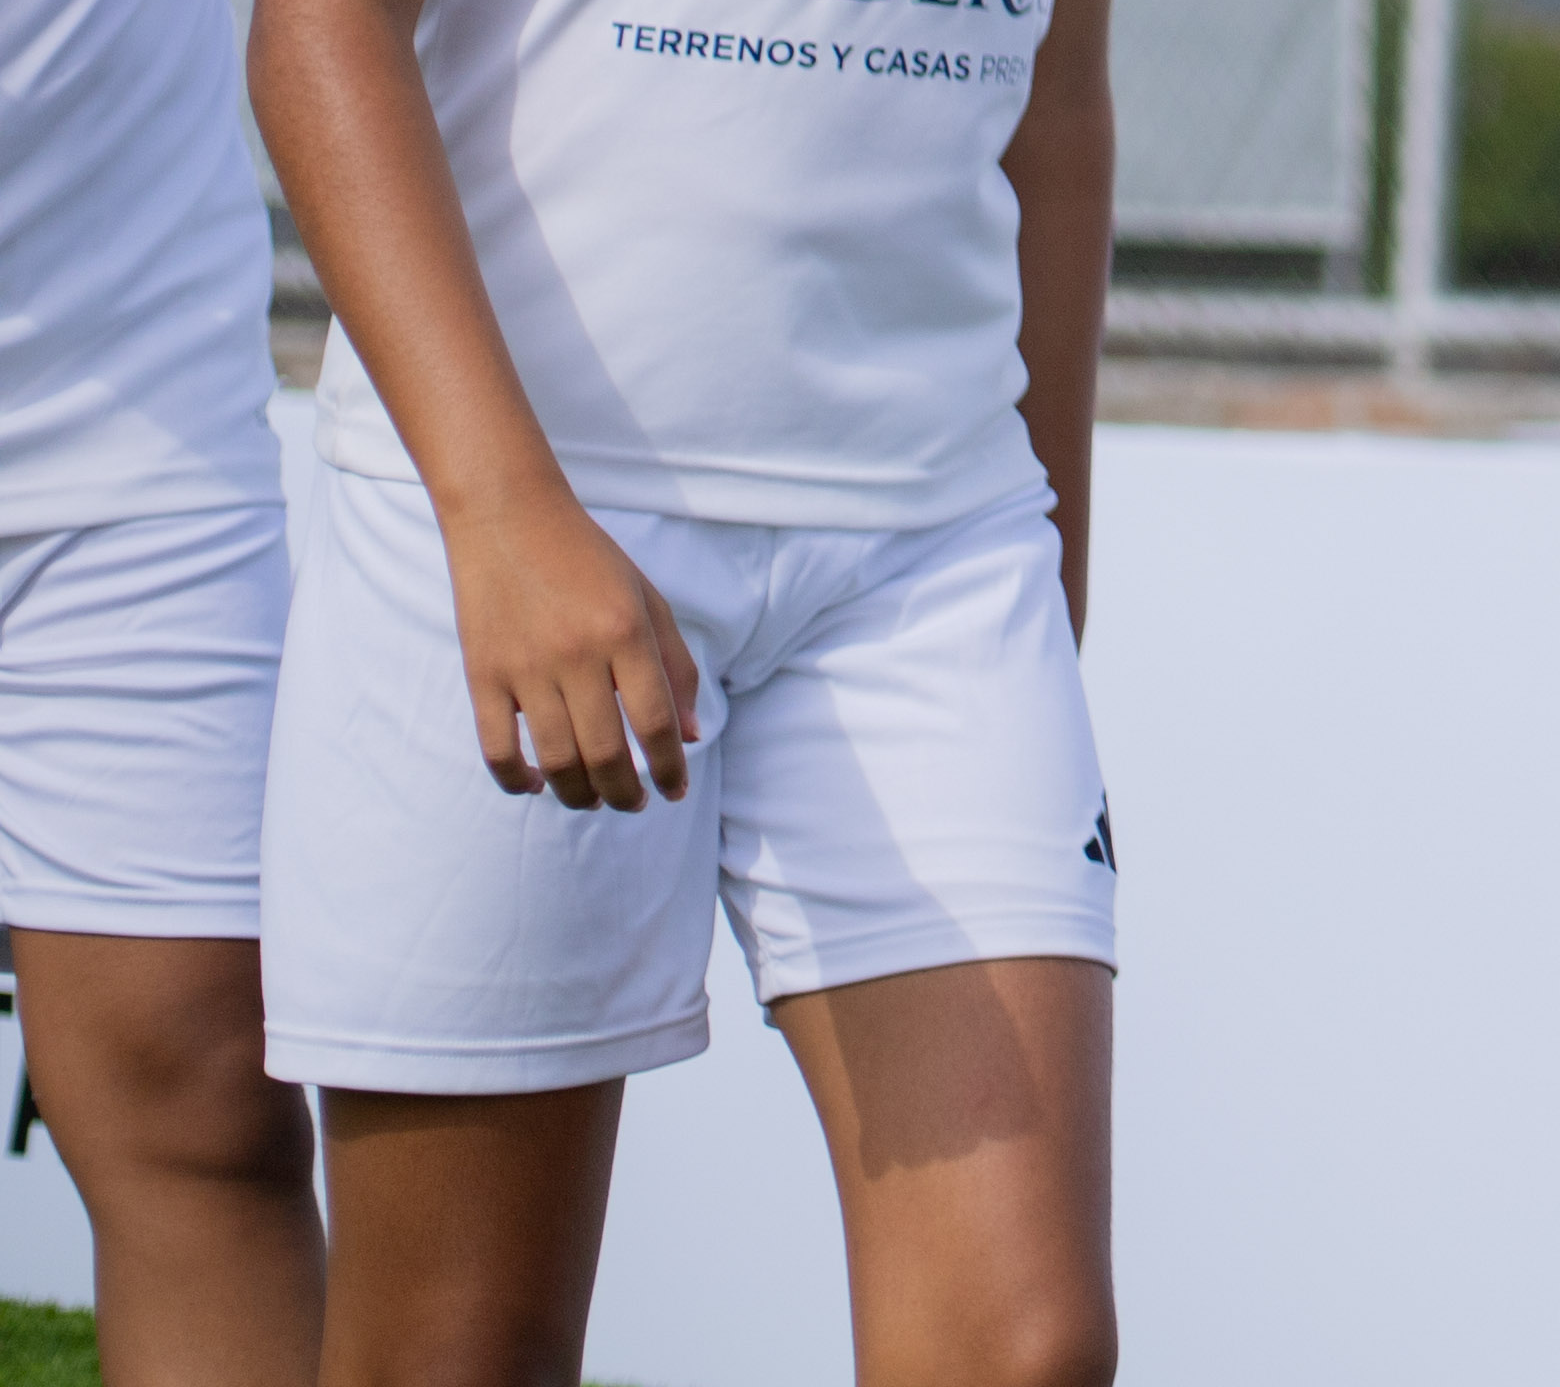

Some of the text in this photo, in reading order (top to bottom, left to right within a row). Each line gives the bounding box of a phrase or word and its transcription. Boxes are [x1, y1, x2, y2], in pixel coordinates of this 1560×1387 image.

[612, 21, 818, 69] TERRENOS
[831, 40, 854, 72] Y
[863, 47, 971, 82] CASAS
